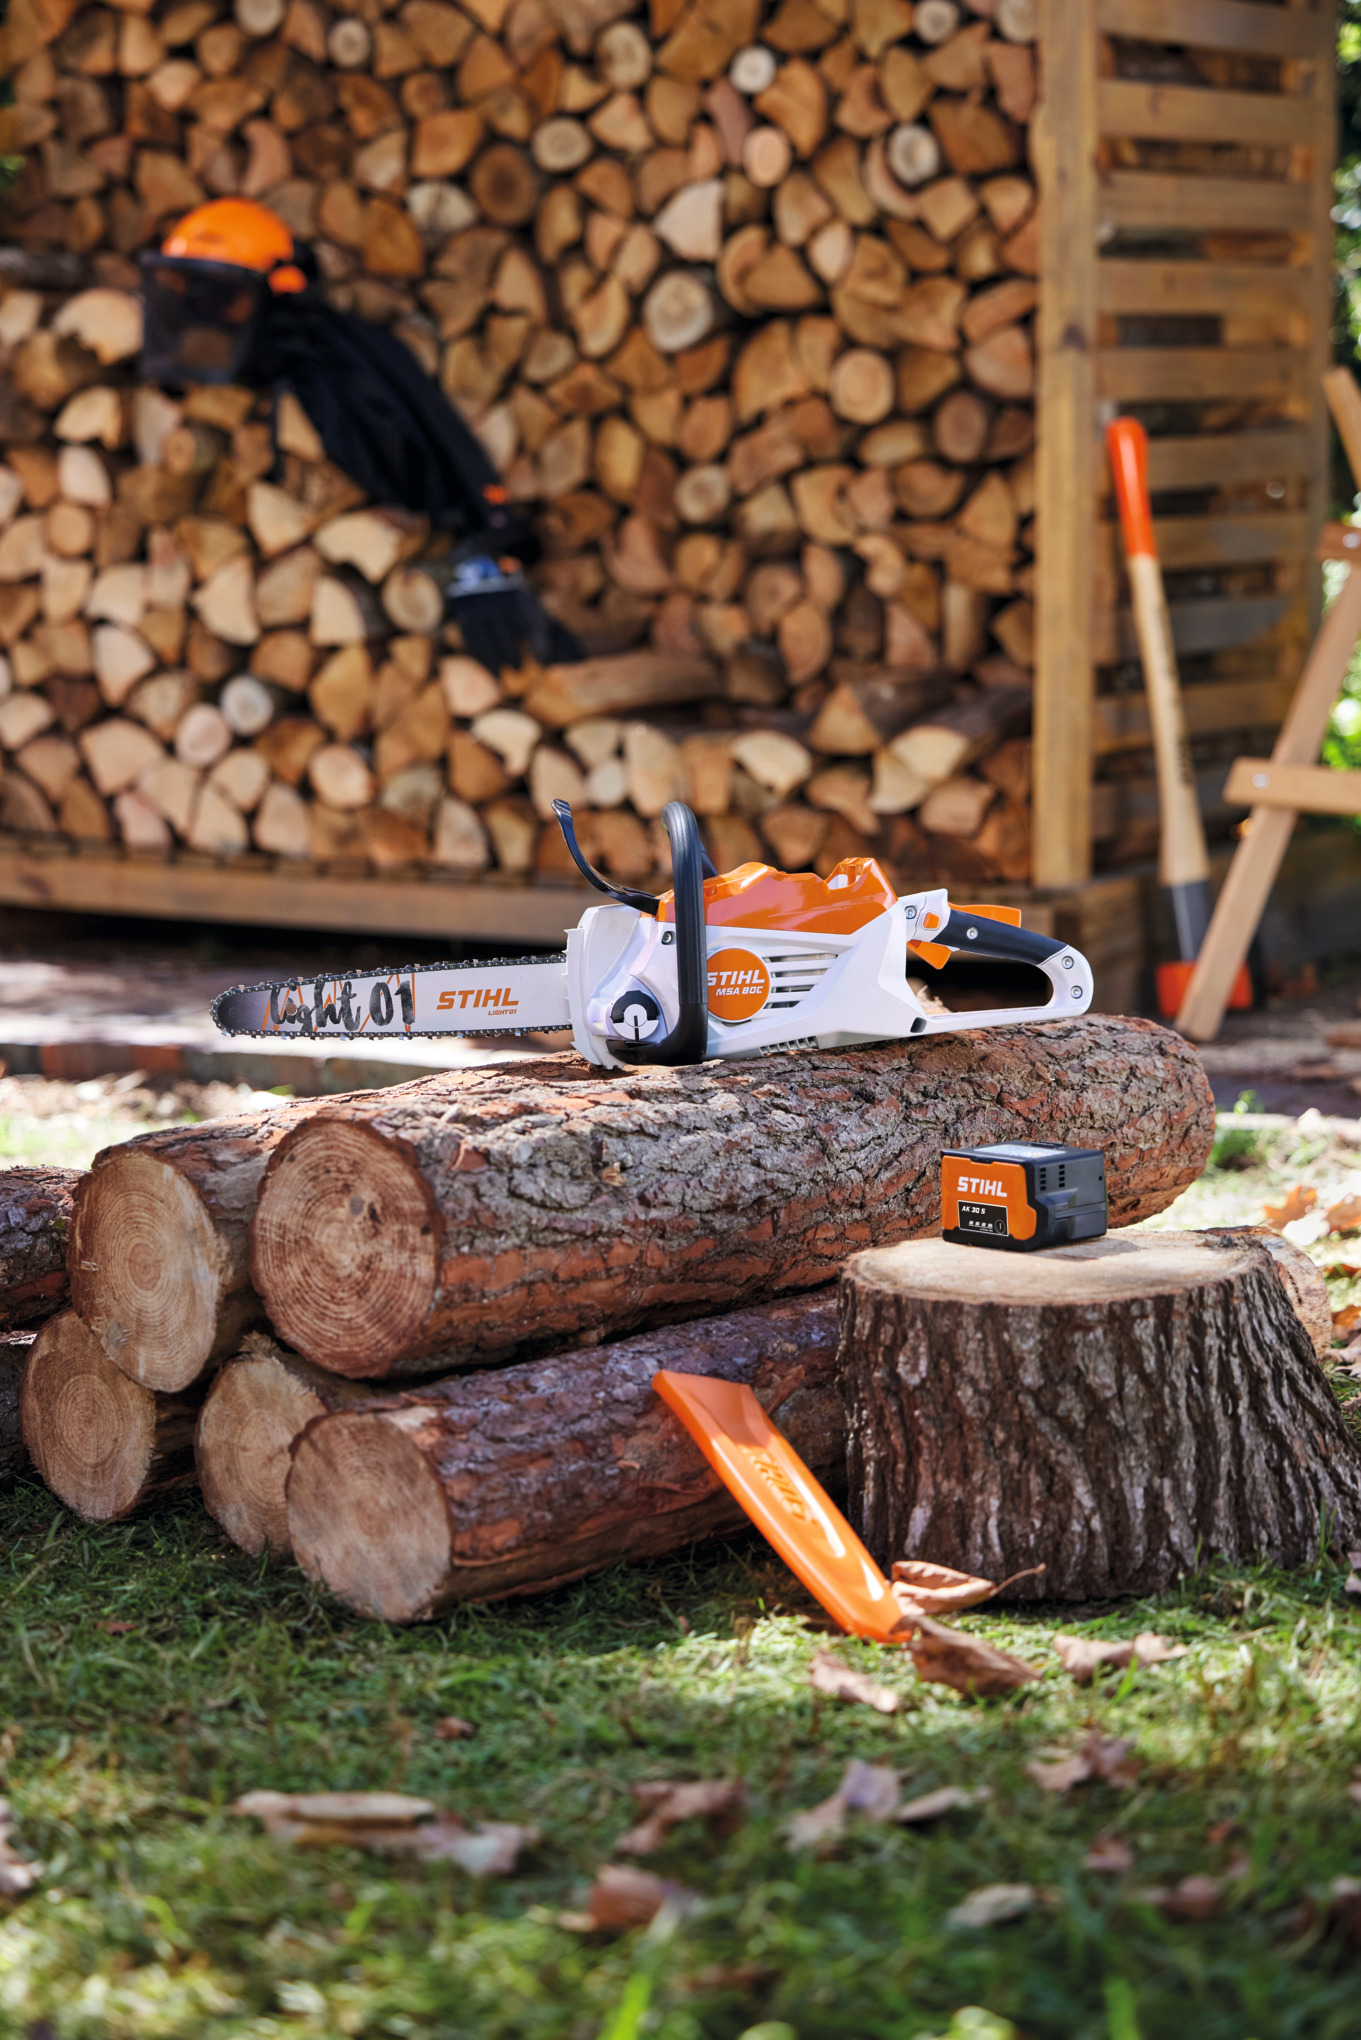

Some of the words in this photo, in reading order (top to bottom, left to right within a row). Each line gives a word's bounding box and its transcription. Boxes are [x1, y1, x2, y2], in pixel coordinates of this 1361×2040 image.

[707, 969, 766, 987] STIHL
[436, 987, 519, 1010] STIHL
[715, 987, 740, 997] MSA
[741, 985, 764, 995] 80C
[369, 980, 416, 1027] 01
[957, 1176, 1008, 1198] STIHL
[961, 1205, 971, 1213] AK
[971, 1206, 980, 1214] 30
